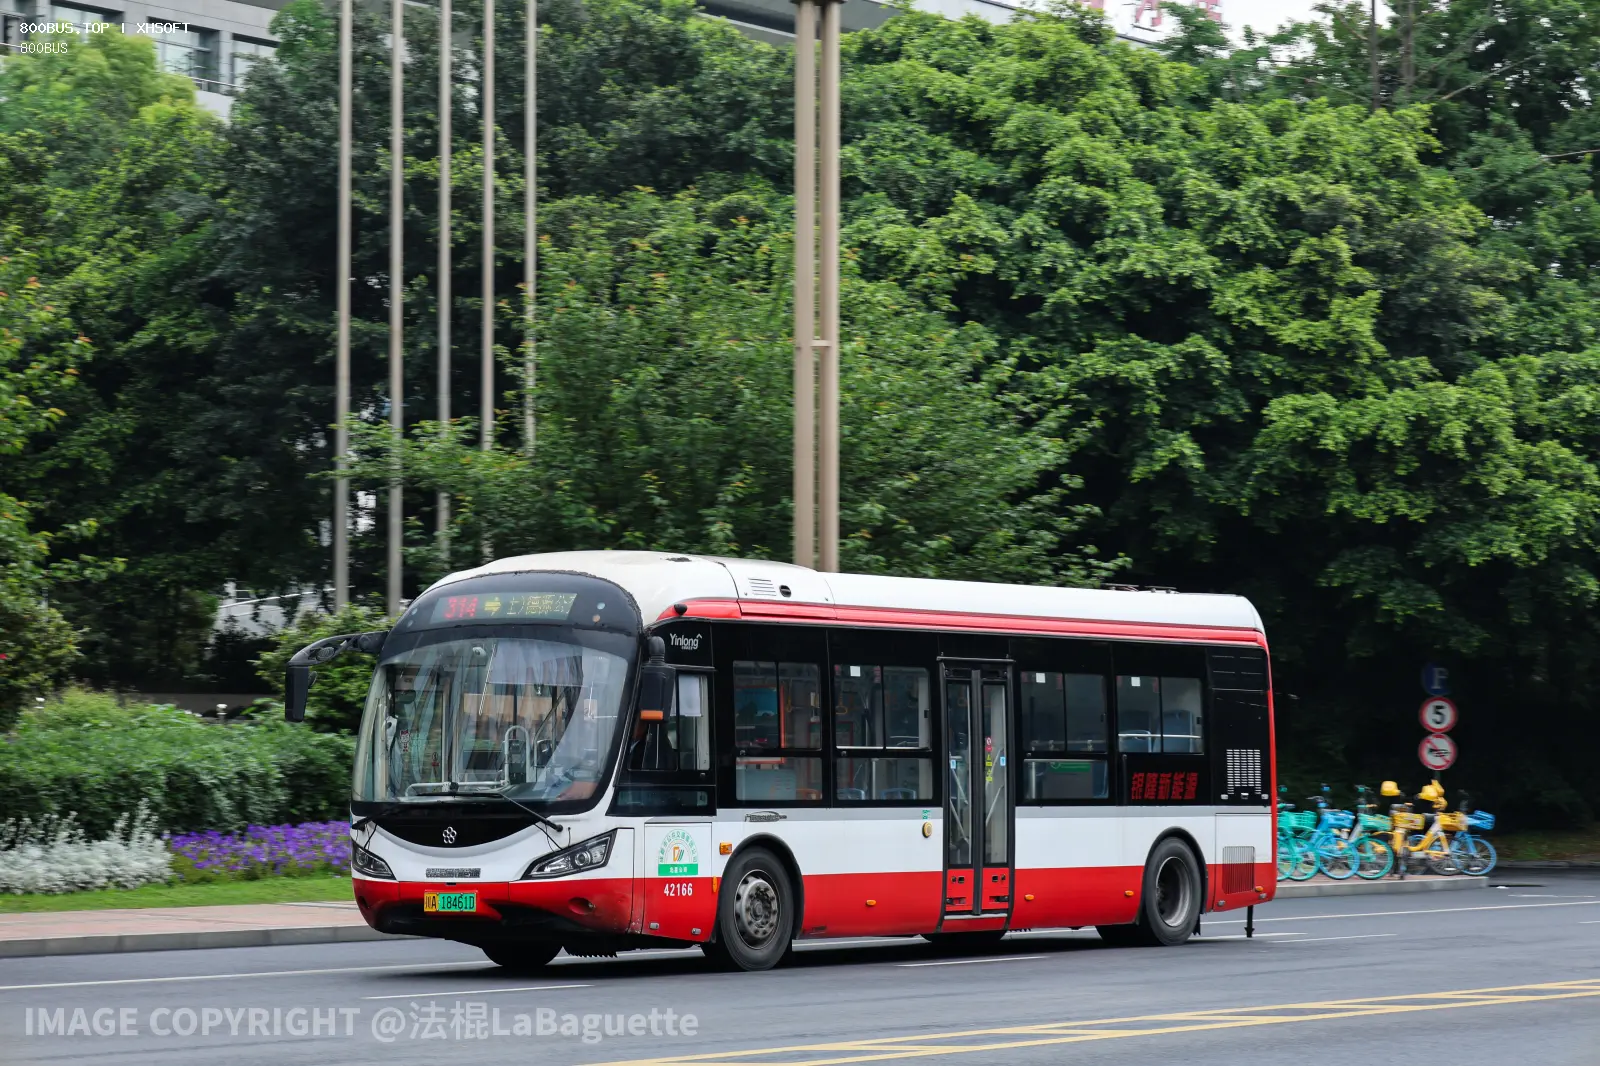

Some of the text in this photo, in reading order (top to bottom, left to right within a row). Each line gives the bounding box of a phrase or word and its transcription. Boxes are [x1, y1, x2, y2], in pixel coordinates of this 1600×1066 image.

[443, 596, 479, 619] 314
[669, 632, 699, 650] Yinlong
[1431, 704, 1447, 725] 5
[1131, 772, 1199, 800] 银隆新能源
[663, 882, 693, 897] 42166
